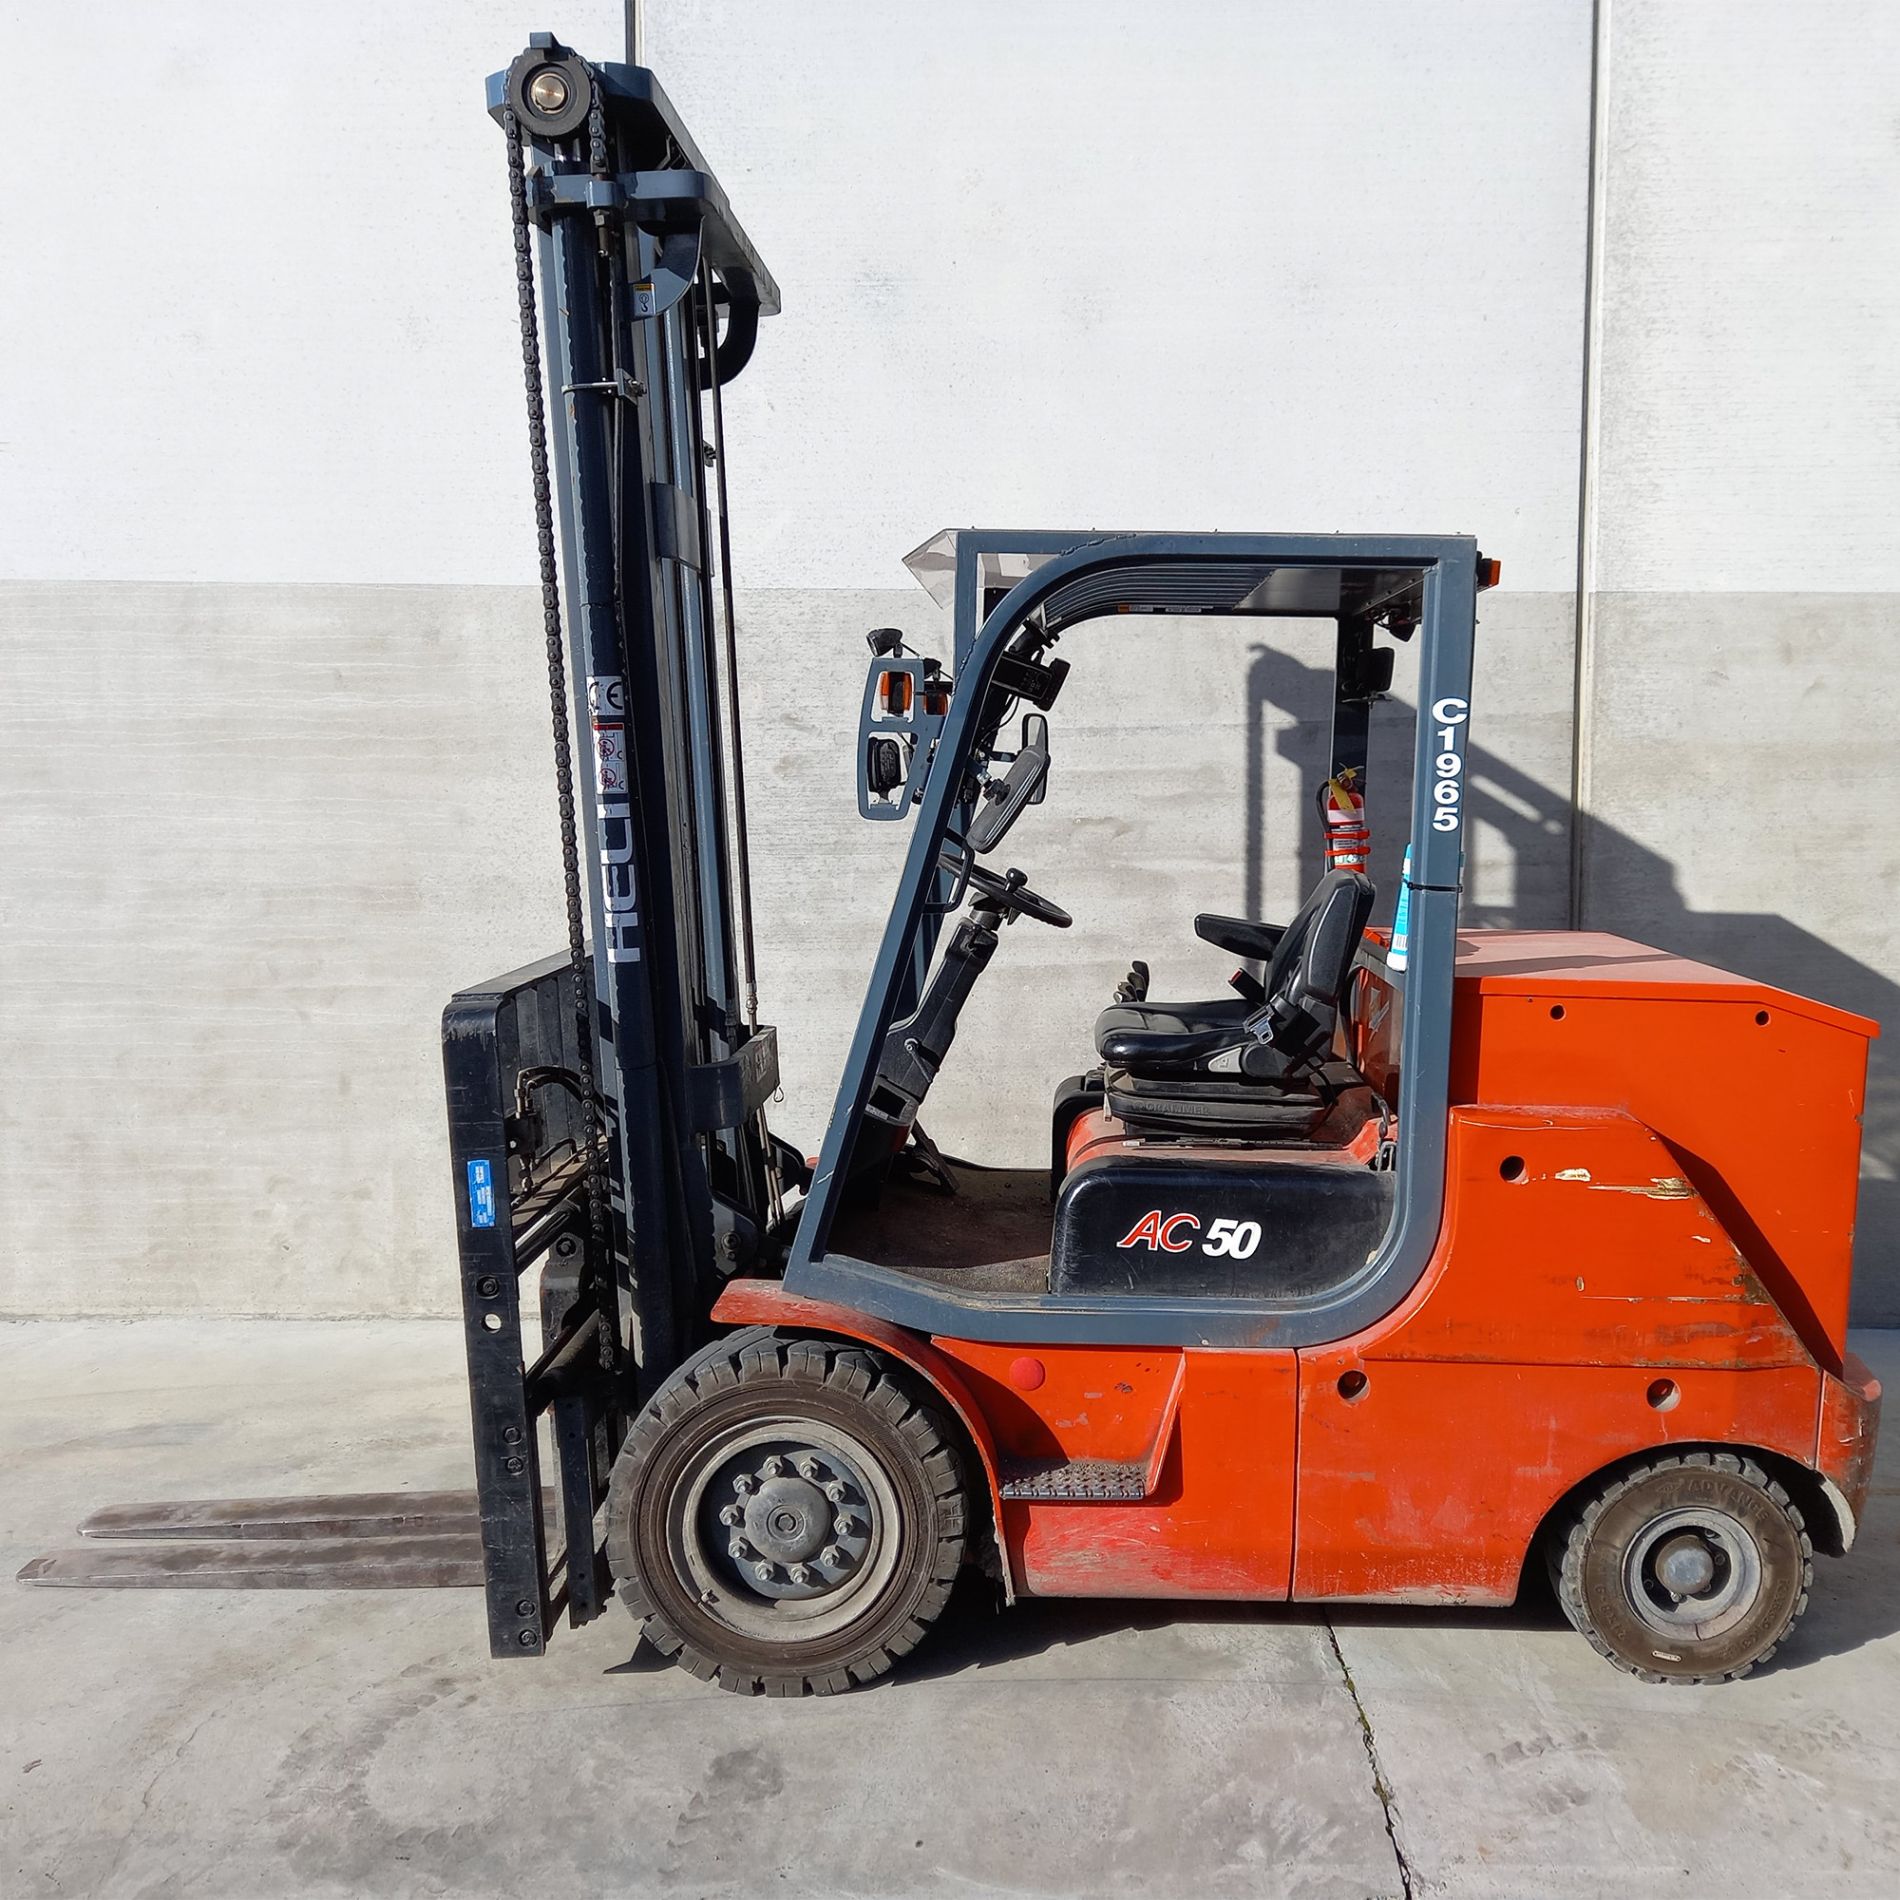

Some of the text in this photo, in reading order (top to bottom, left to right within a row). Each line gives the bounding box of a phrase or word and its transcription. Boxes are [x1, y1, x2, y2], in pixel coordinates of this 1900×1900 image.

[1431, 697, 1468, 832] C1965
[596, 802, 641, 962] HELI
[1116, 1210, 1262, 1260] AC 50
